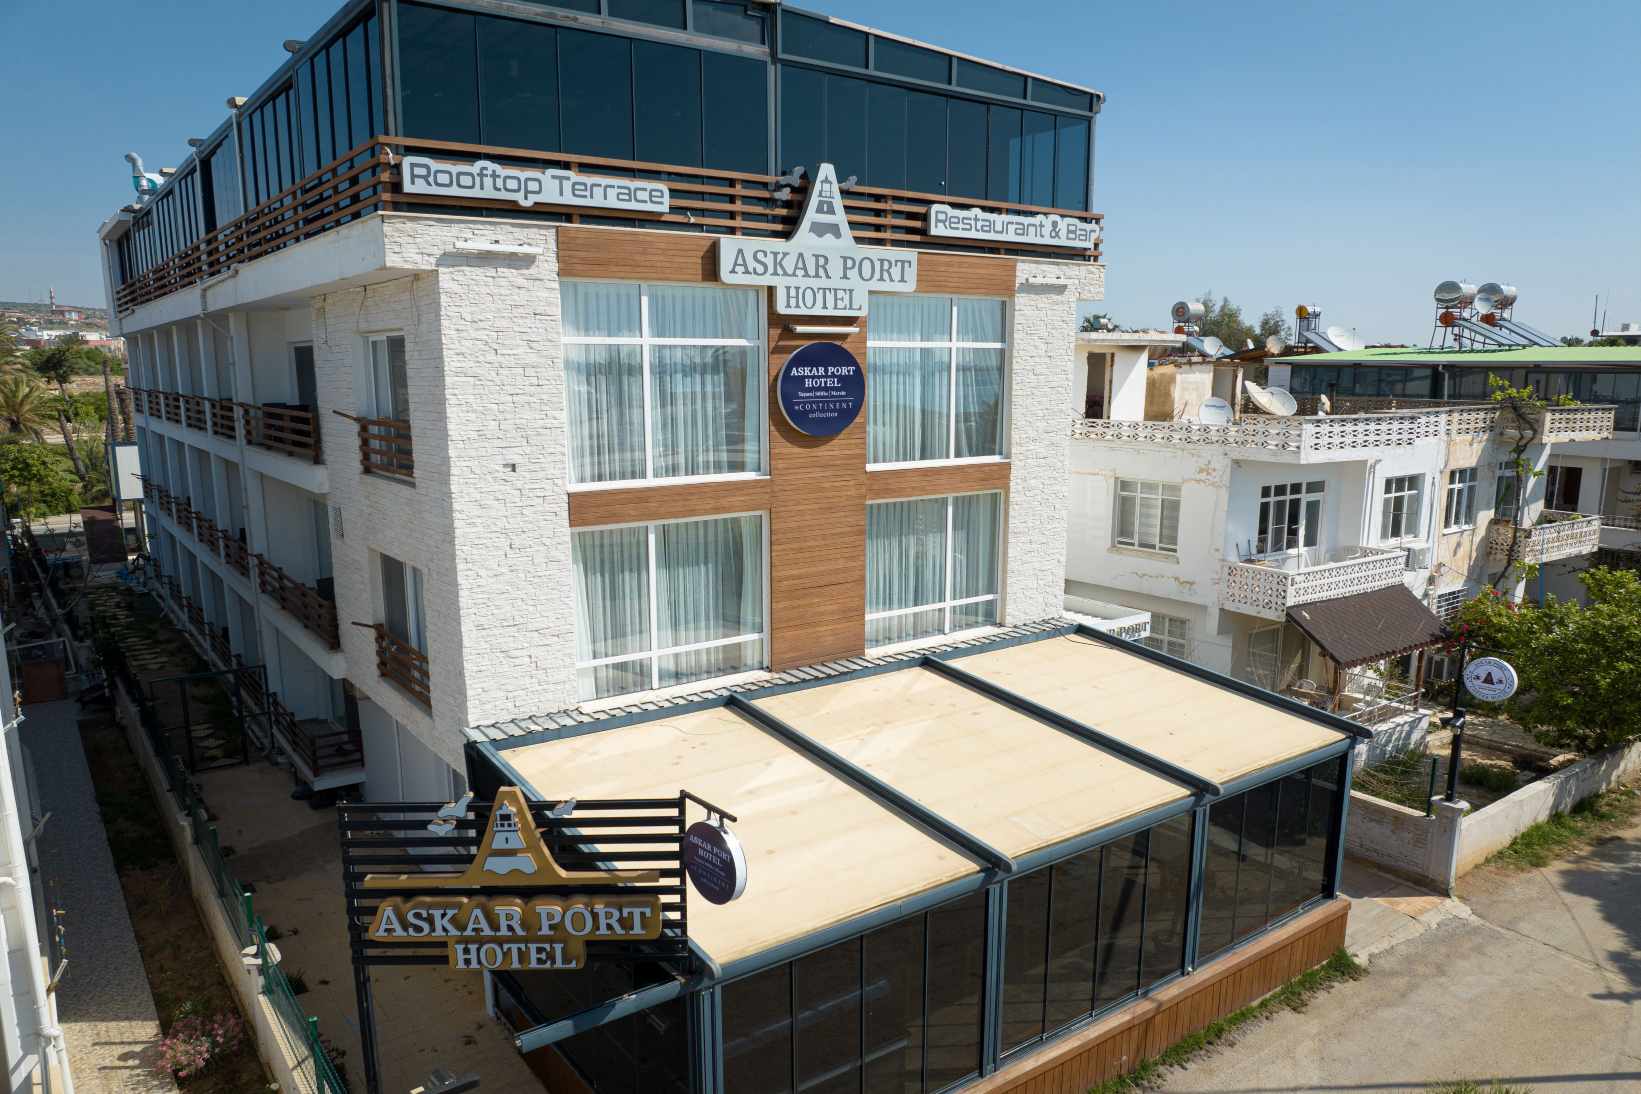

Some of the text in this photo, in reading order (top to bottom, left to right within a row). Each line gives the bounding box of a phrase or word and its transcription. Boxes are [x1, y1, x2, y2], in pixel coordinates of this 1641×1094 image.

[409, 162, 665, 205] Rooftop Terrace
[934, 210, 1096, 242] Restaurant & Bar
[729, 248, 912, 283] ASKAR PORT
[784, 286, 862, 311] HOTEL
[791, 366, 855, 376] ASKAR PORT
[805, 378, 840, 387] HOTEL
[689, 834, 731, 863] ASKAR PORT
[698, 847, 721, 865] HOTEL
[375, 905, 651, 937] ASKAR PORT
[454, 943, 577, 969] HOTEL
